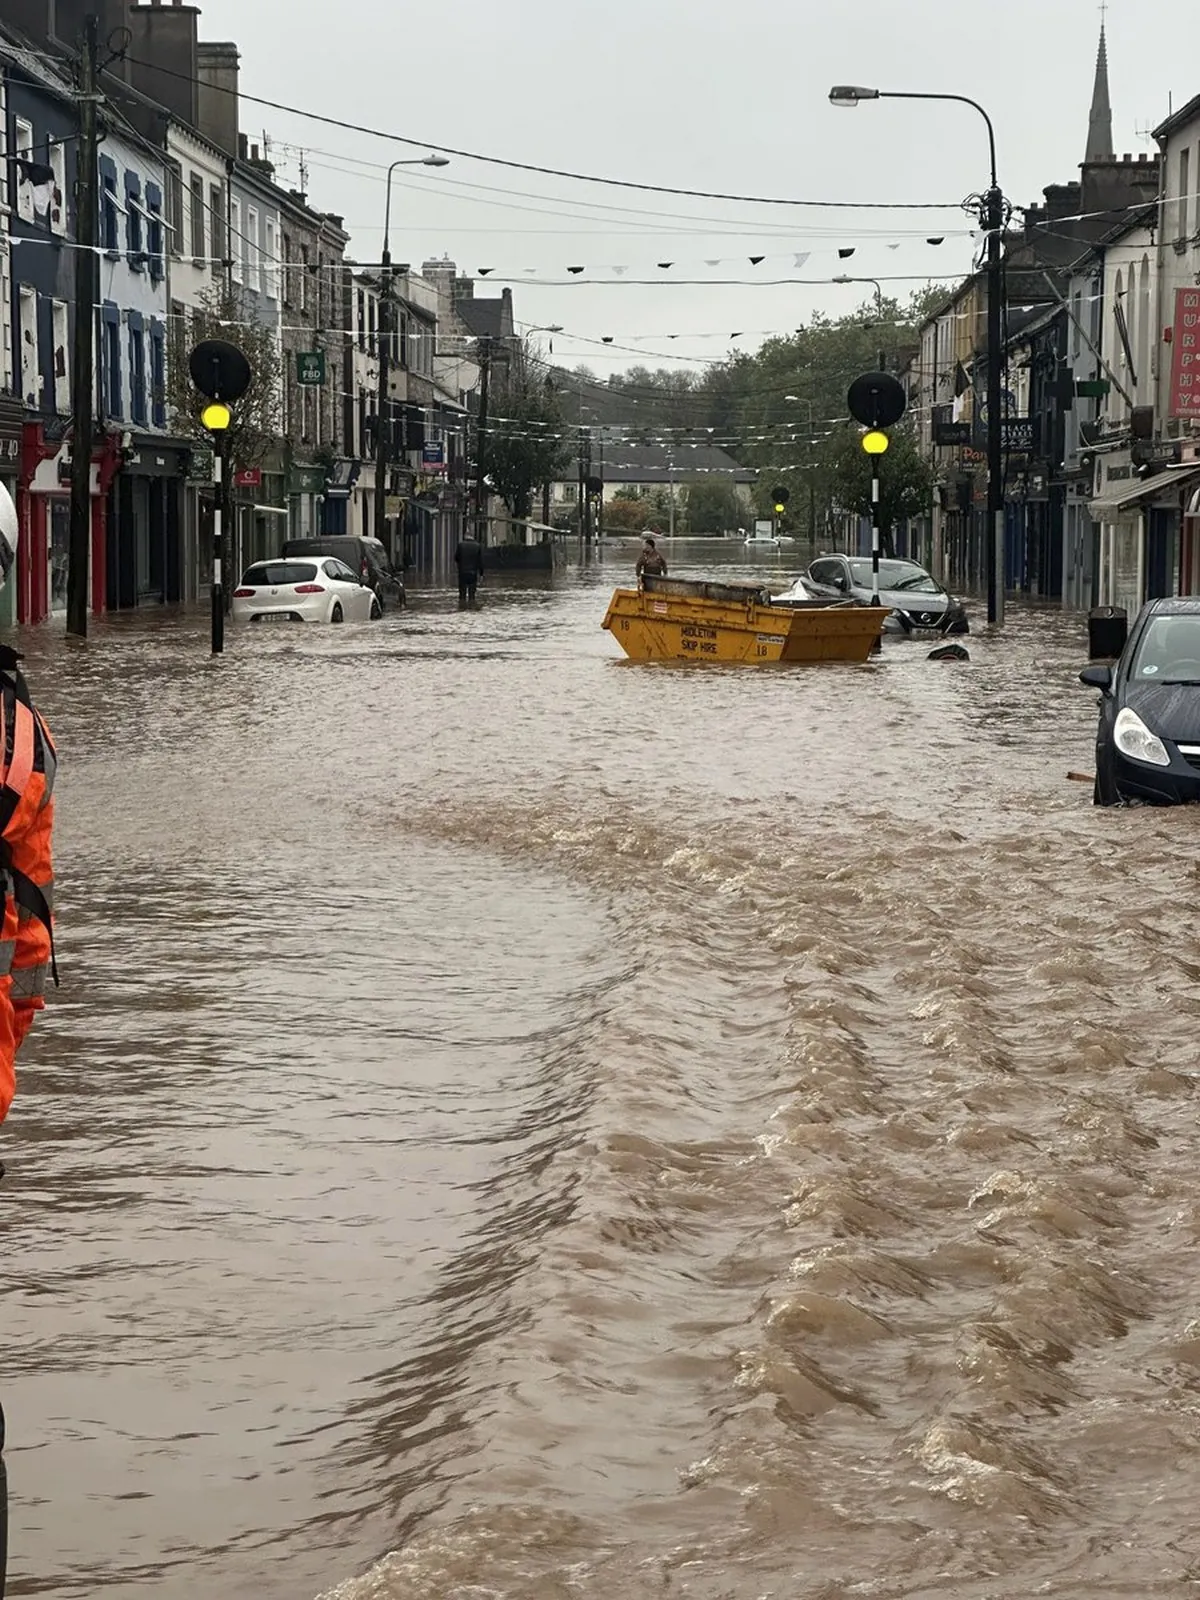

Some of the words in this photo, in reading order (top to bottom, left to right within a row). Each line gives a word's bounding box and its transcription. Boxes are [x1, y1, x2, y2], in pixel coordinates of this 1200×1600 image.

[1178, 293, 1199, 407] MURPHY
[302, 370, 321, 379] FBD
[621, 619, 630, 631] 18
[681, 639, 698, 652] SKIP
[700, 642, 717, 654] HIRE
[757, 645, 767, 656] 18
